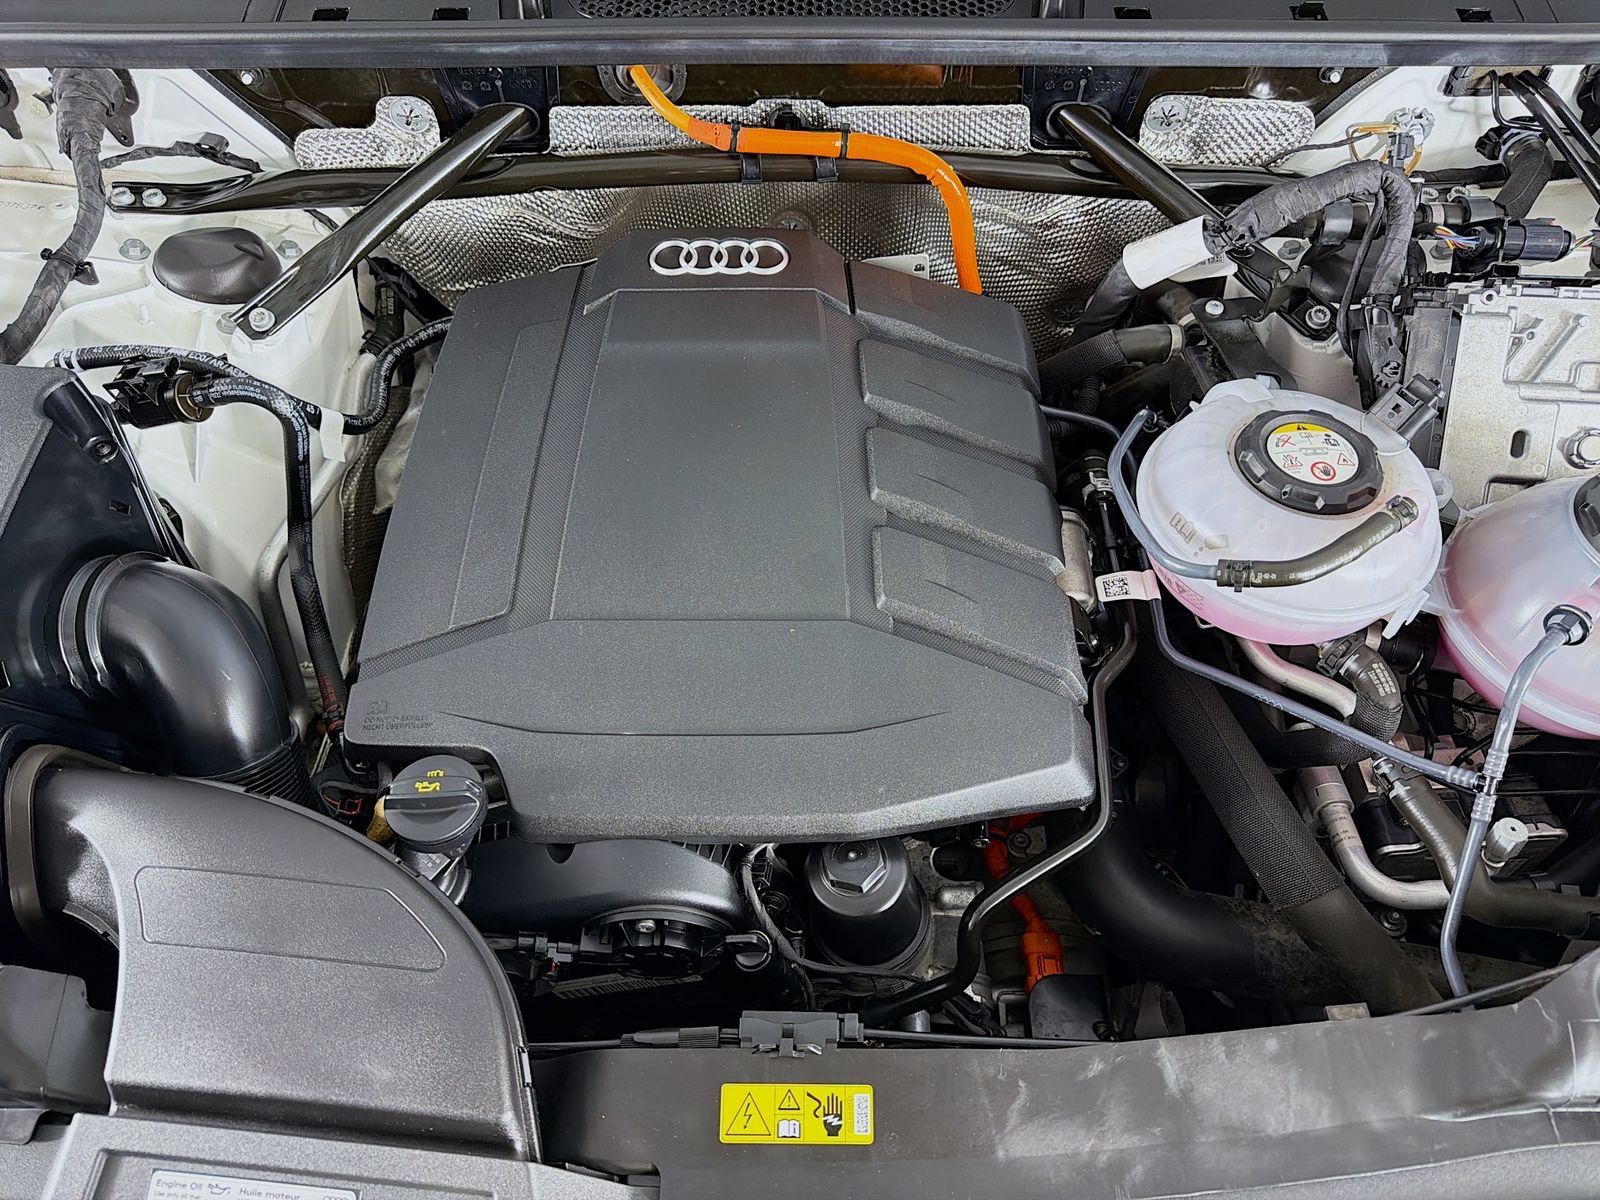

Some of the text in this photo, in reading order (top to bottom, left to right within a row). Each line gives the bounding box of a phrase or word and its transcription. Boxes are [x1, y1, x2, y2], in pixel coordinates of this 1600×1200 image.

[156, 1179, 301, 1200] Engine Oil Huile moteur
